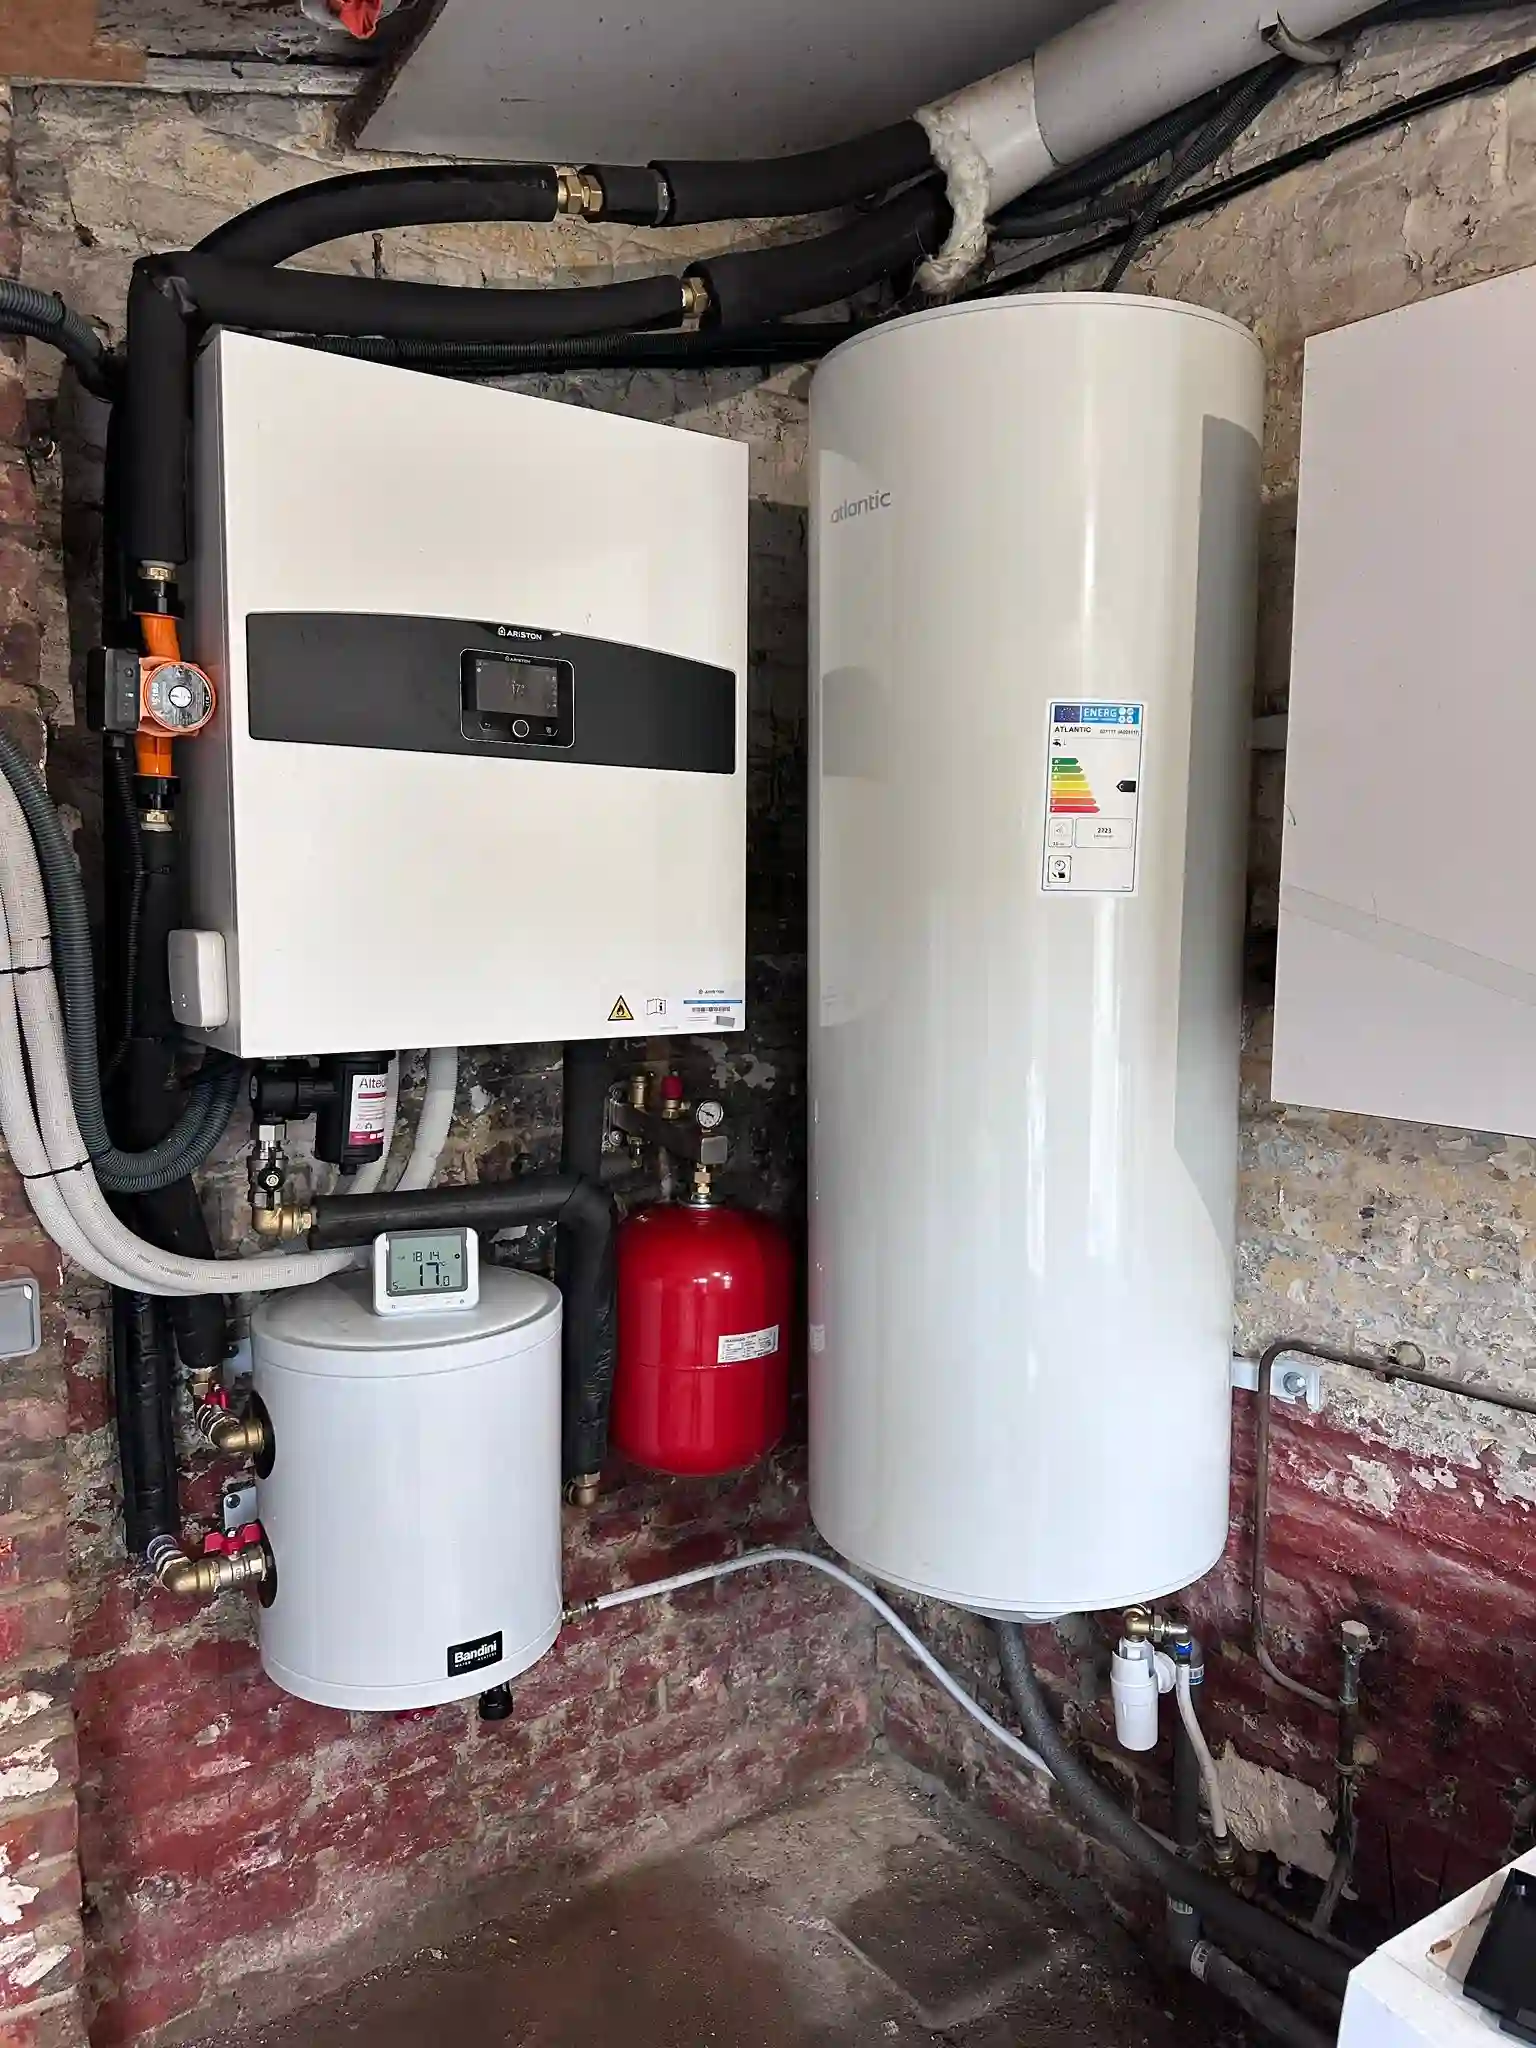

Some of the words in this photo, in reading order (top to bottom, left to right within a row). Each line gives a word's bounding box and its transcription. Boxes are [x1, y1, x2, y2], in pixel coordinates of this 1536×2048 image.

[830, 489, 891, 523] atlantic
[506, 629, 543, 641] ARISTON
[1083, 707, 1117, 718] ENERG
[454, 1640, 497, 1663] Bandini
